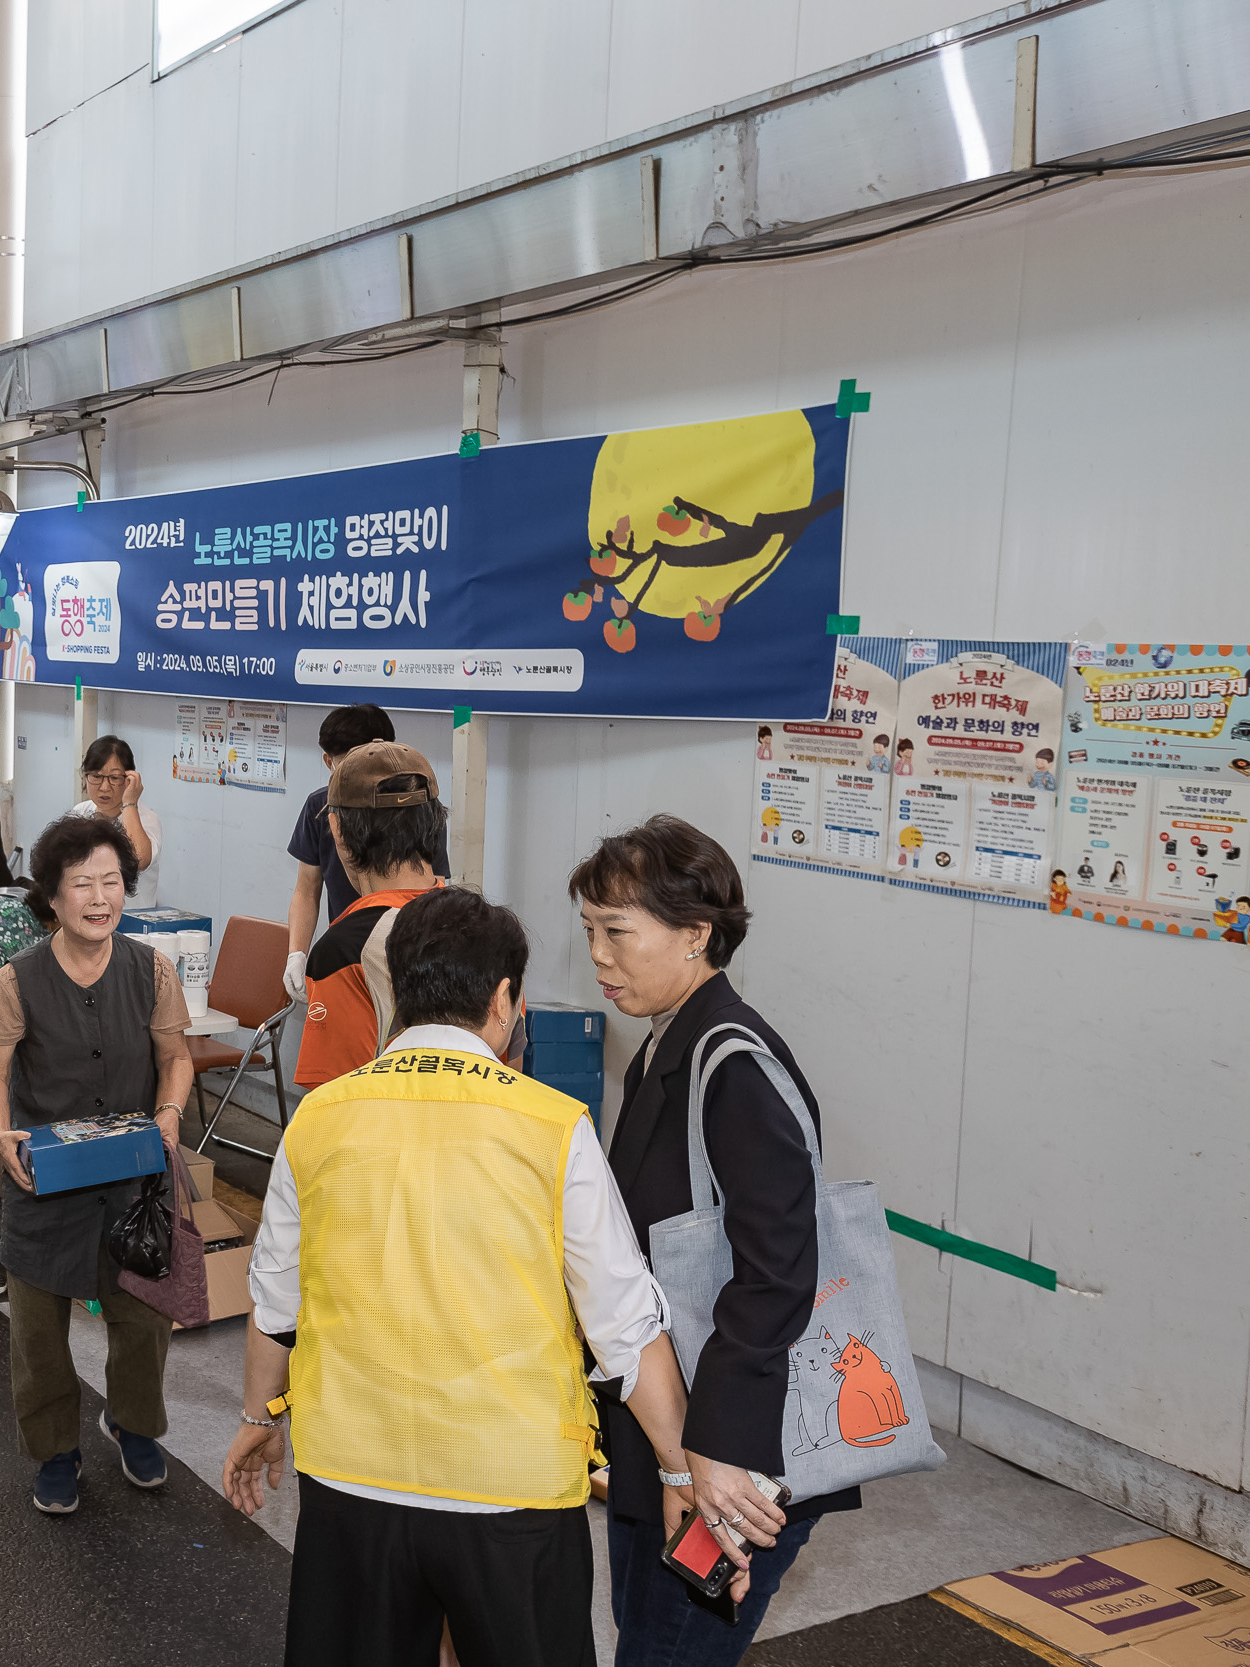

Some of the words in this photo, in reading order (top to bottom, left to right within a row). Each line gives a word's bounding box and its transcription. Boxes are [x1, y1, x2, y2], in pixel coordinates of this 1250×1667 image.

[124, 518, 185, 550] 2024년
[193, 517, 338, 566] 노룬산골목시장
[344, 505, 448, 558] 명절맞이
[156, 576, 287, 632] 송편만들기
[297, 569, 431, 630] 체험행사
[98, 625, 111, 633] 2024
[62, 644, 93, 654] K-SHOPPING
[93, 645, 111, 655] FESTA
[136, 652, 155, 672] 일시
[242, 657, 276, 675] 17:00
[304, 661, 328, 673] 서울특별시
[398, 662, 455, 676] 소상공인시장진흥공단
[525, 664, 573, 675] 노룬산골목시장
[957, 669, 1006, 689] 노룬산
[1083, 684, 1130, 702] 노룬산
[1133, 681, 1185, 700] 한가위
[1189, 678, 1248, 697] 대축제
[931, 691, 977, 711] 한가위
[981, 693, 1029, 717] 대축제
[917, 715, 958, 731] 예술과
[962, 718, 1006, 735] 문화의
[1011, 721, 1040, 738] 향연
[350, 1054, 518, 1086] 노룬산골목시장
